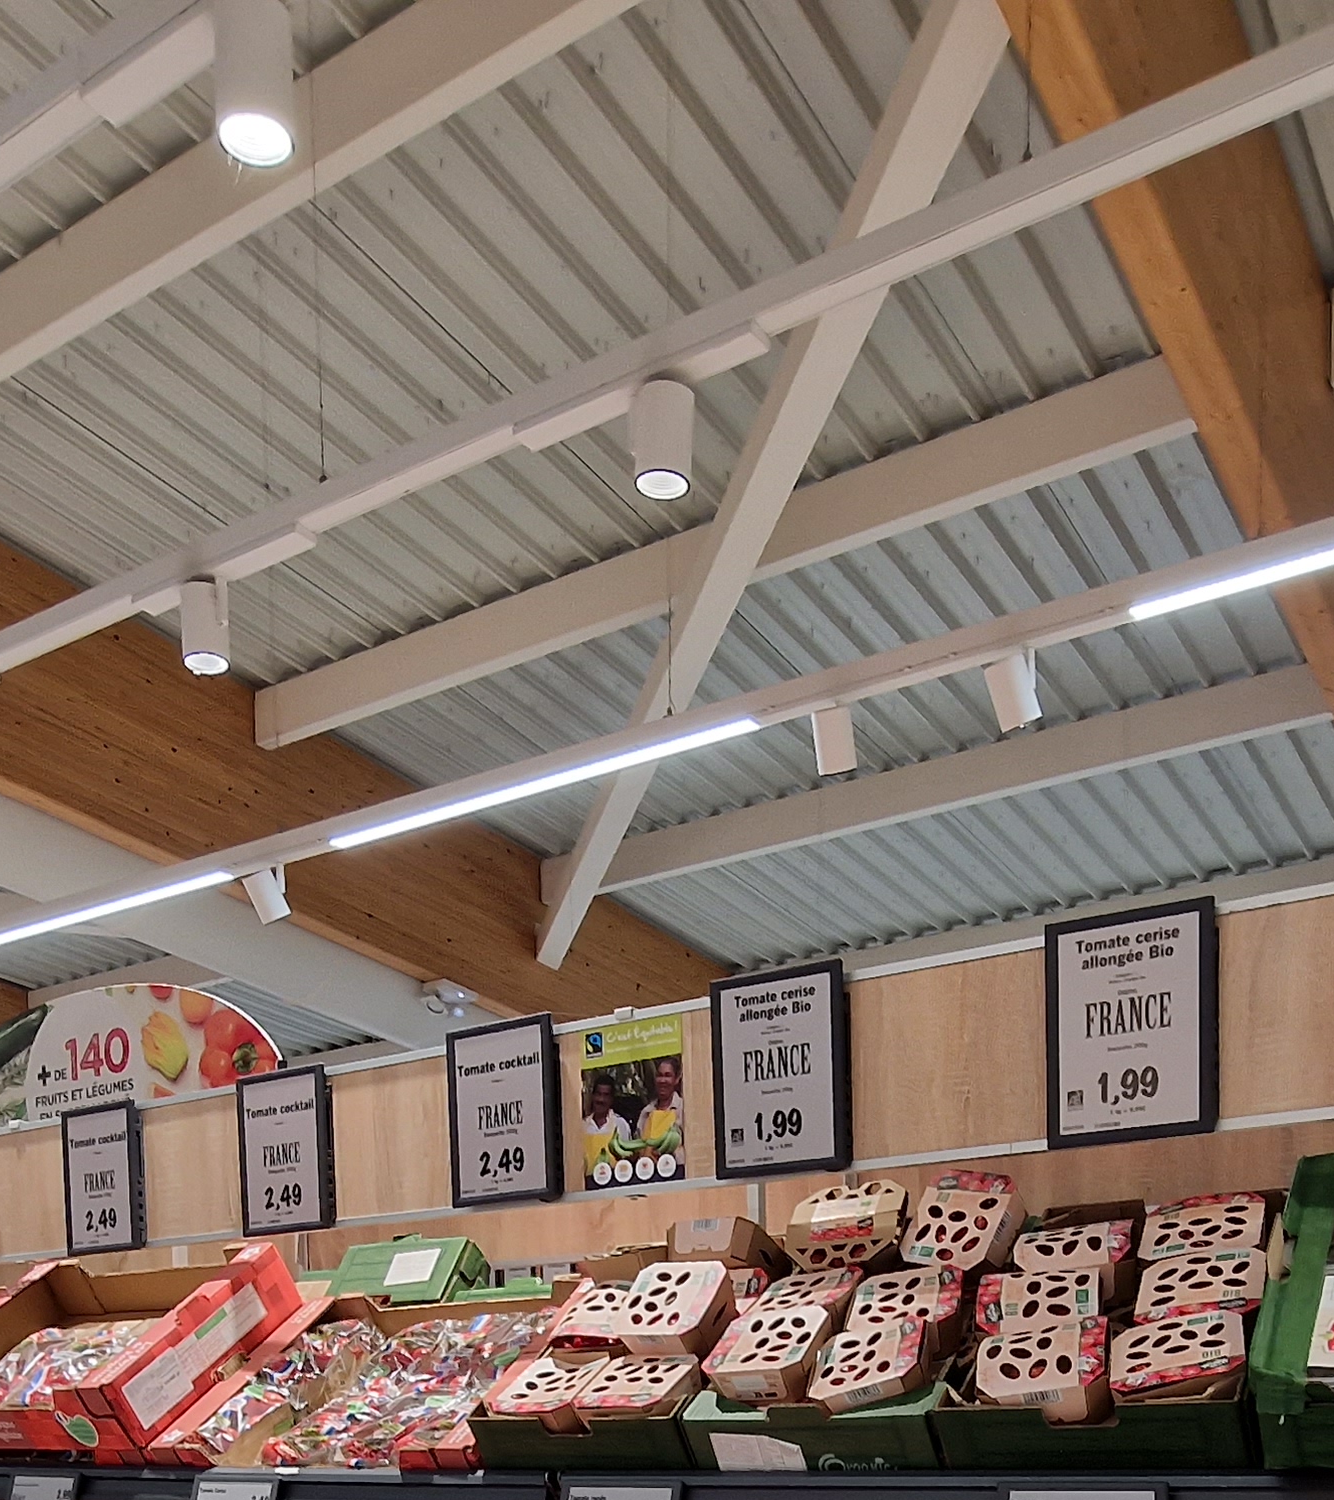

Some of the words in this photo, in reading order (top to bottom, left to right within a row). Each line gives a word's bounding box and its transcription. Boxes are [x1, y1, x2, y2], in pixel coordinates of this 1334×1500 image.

[1075, 936, 1130, 954] Tomate
[1135, 926, 1180, 944] cerise
[1081, 949, 1143, 970] allongée
[1149, 945, 1174, 960] Bio
[734, 992, 777, 1009] Tomate
[781, 985, 816, 1001] cerise
[739, 1005, 787, 1023] allongée
[792, 1001, 812, 1014] Bio
[1085, 992, 1172, 1039] FRANCE
[54, 1069, 67, 1082] DE
[65, 1027, 131, 1081] 140
[457, 1061, 495, 1078] Tomate
[499, 1052, 540, 1069] cocktail
[743, 1043, 811, 1083] FRANCE
[35, 1090, 69, 1108] FRUITS
[71, 1088, 85, 1101] ET
[86, 1078, 134, 1099] LÉGUMES
[1097, 1065, 1159, 1106] 1,99
[246, 1107, 277, 1121] Tomate
[280, 1098, 314, 1113] cocktail
[477, 1100, 523, 1131] FRANCE
[754, 1107, 802, 1142] 1,99
[69, 1135, 96, 1149] Tomate
[98, 1131, 126, 1145] cocktail
[263, 1142, 301, 1168] FRANCE
[479, 1147, 524, 1178] 2,49
[84, 1169, 116, 1193] FRANCE
[264, 1183, 302, 1211] 2,49
[85, 1207, 117, 1232] 2,49
